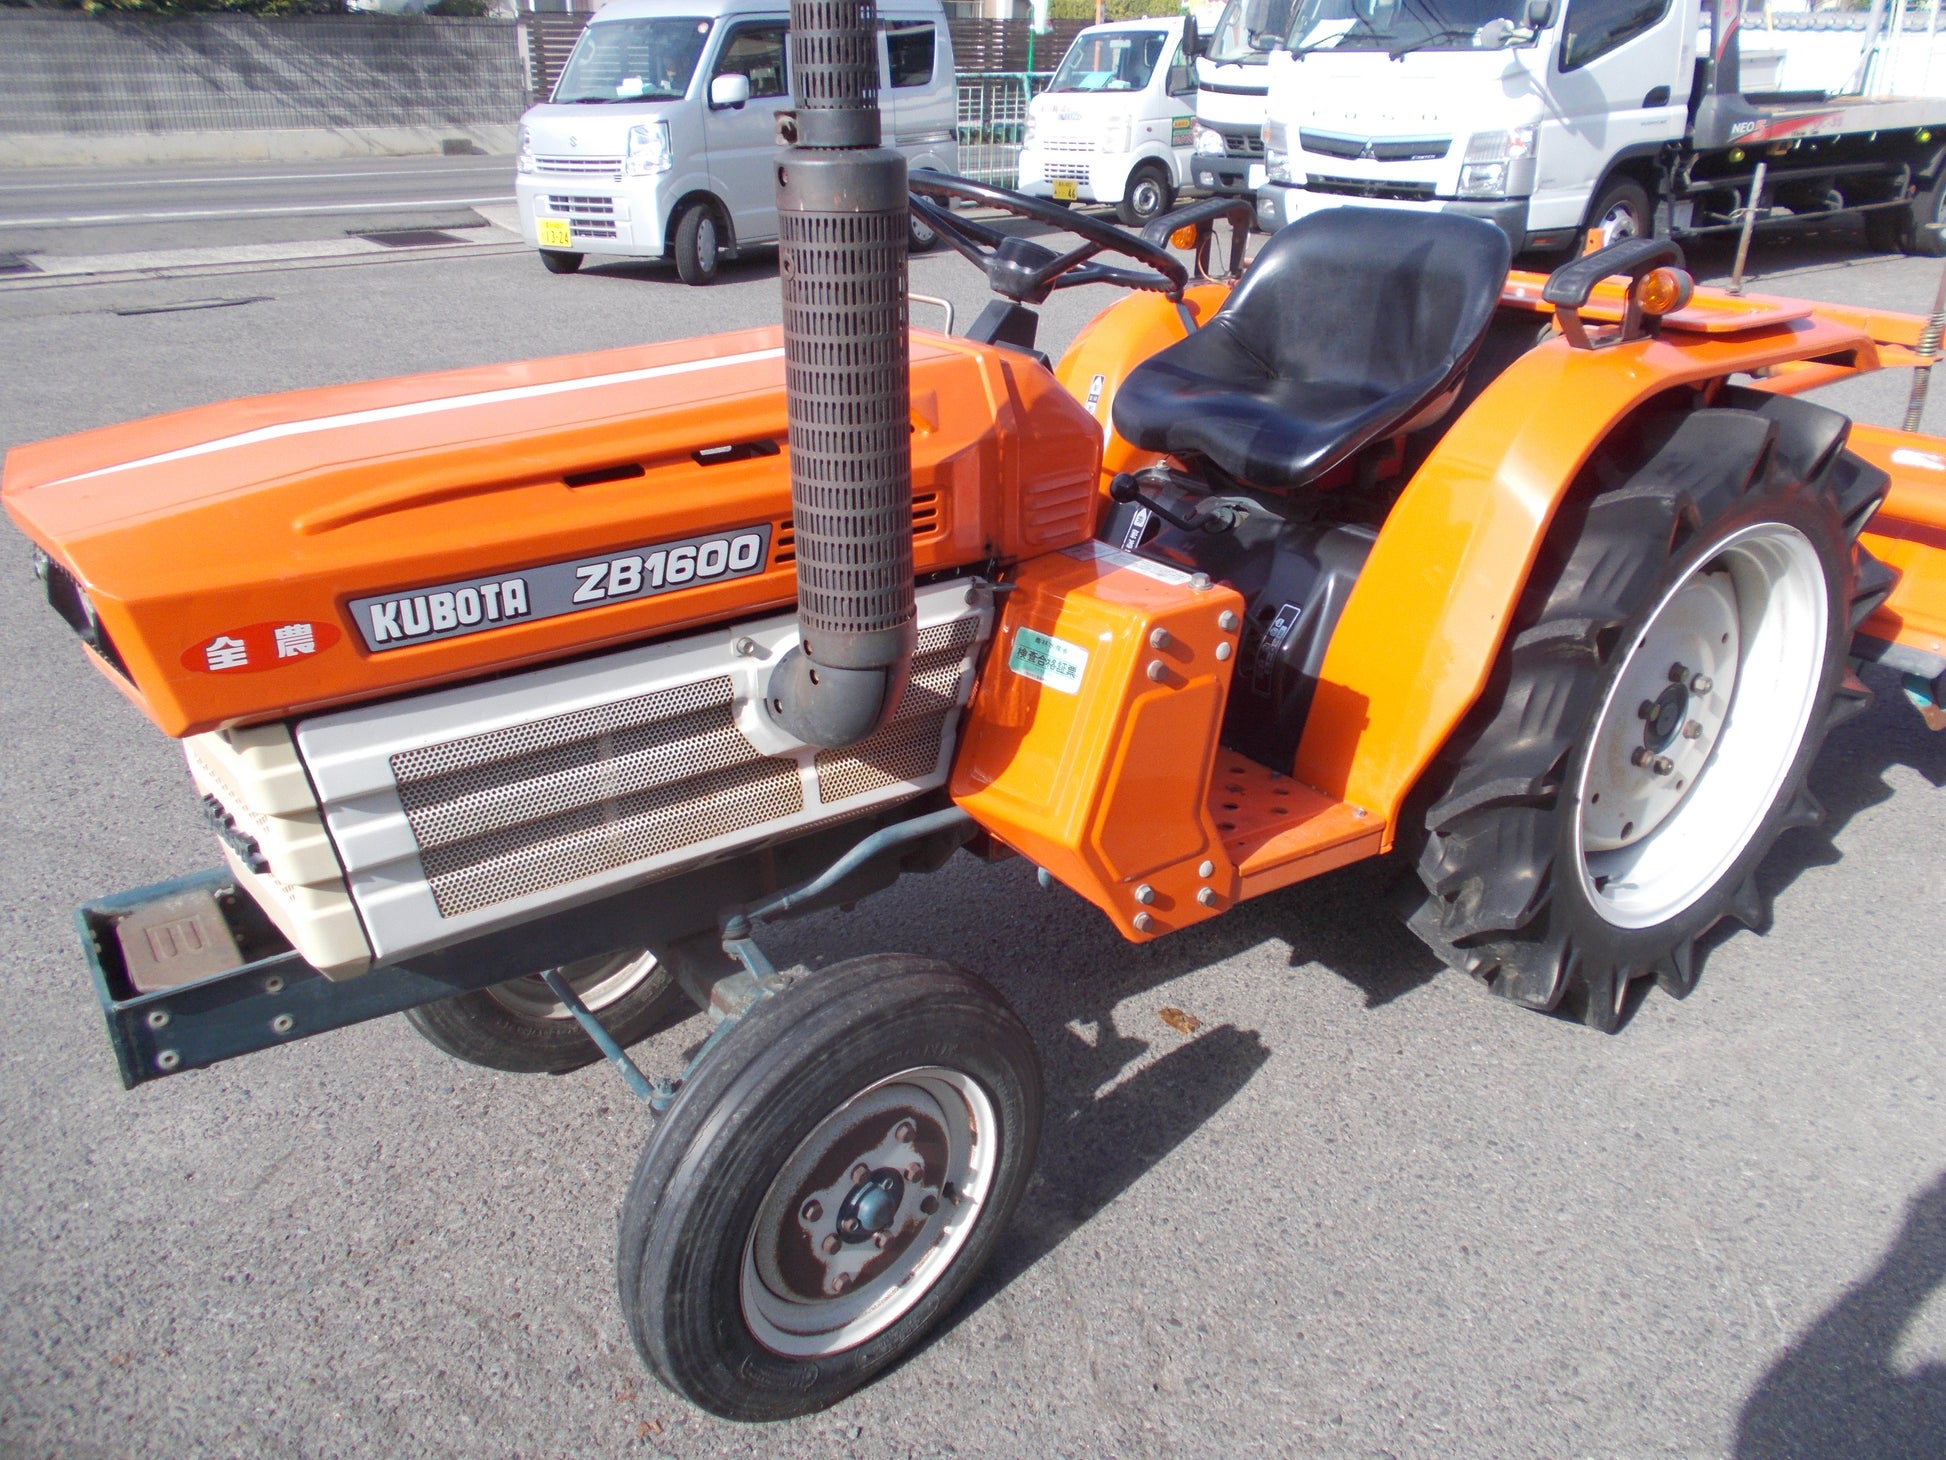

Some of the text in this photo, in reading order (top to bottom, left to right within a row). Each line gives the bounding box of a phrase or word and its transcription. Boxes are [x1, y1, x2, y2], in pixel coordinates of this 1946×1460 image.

[1731, 121, 1755, 134] NEO
[369, 533, 762, 643] KUBOTA ZB1600
